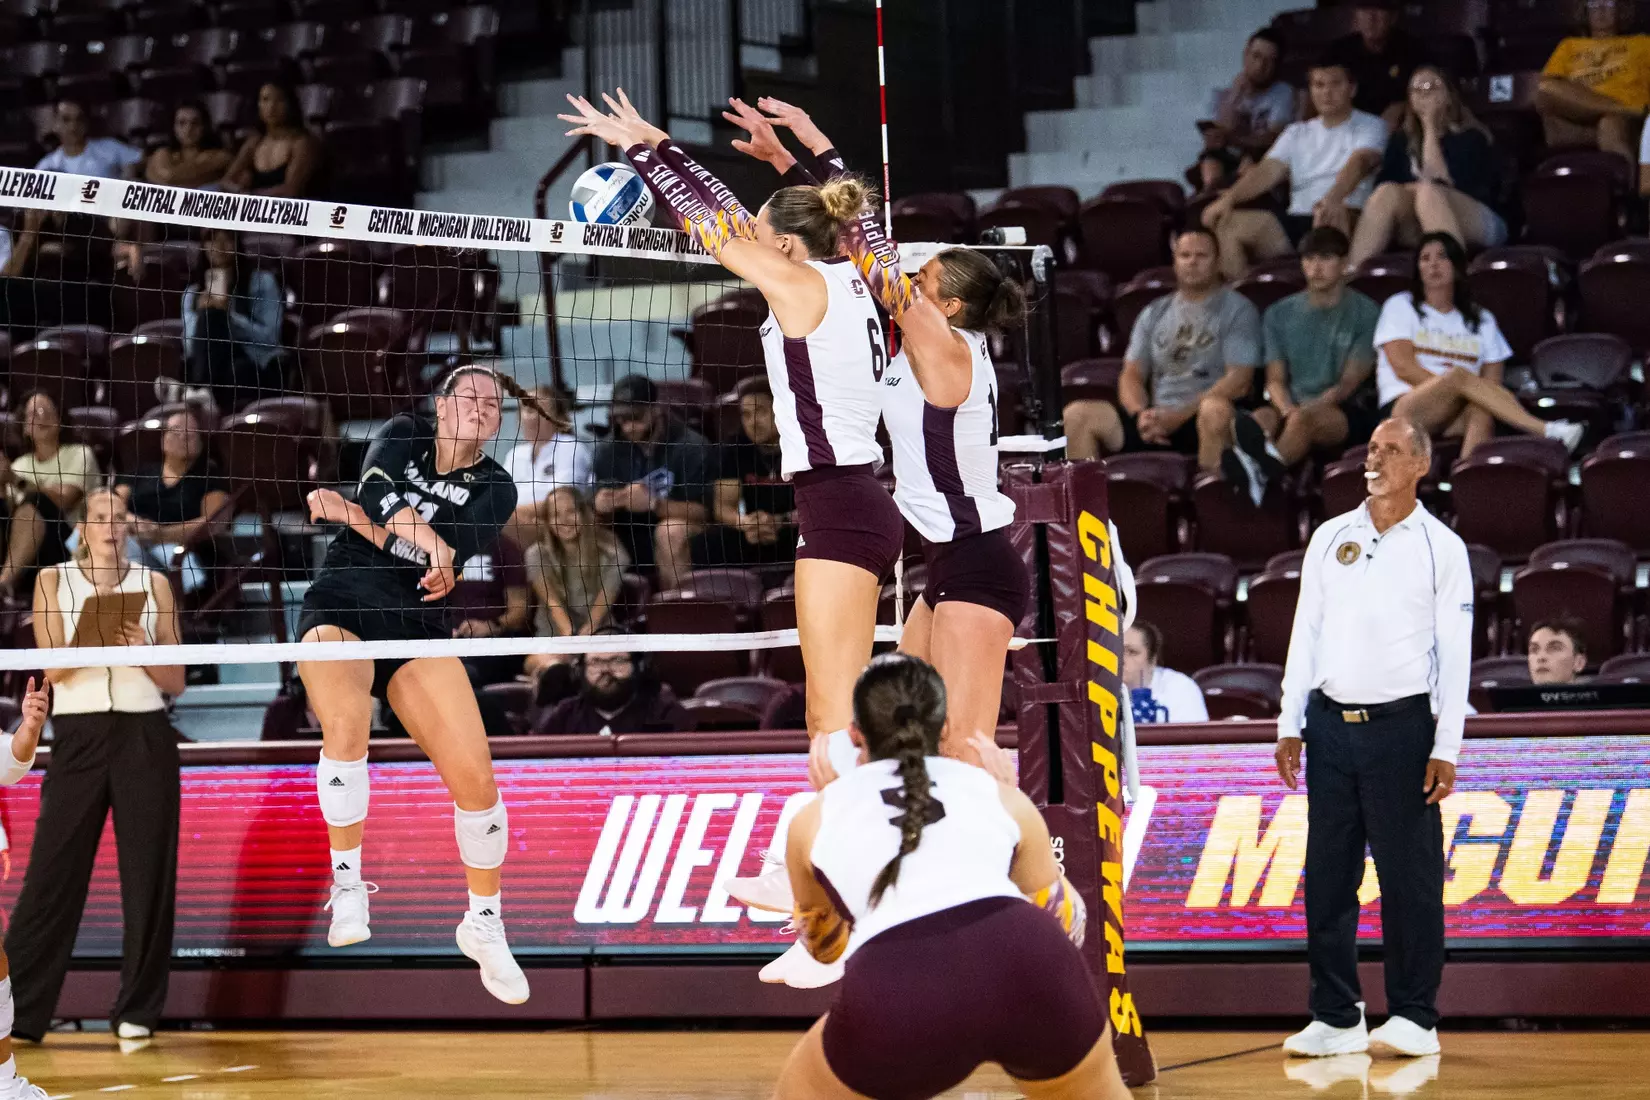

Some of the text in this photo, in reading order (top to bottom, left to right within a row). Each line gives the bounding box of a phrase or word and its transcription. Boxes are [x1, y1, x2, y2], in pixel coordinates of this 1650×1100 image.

[0, 170, 57, 200] LEYBALL
[121, 184, 178, 215] CENTRAL
[178, 191, 241, 221] MICHIGAN
[239, 198, 310, 226] VOLLEYBALL
[367, 208, 414, 235] CENTRAL
[416, 212, 470, 239] MICHIGAN
[470, 217, 531, 242] VOLLEYBALL
[582, 223, 624, 248] CENTRAL
[626, 226, 674, 252] MICHIGAN
[619, 193, 649, 226] molte
[647, 163, 715, 224] CHIPPEWAS
[857, 208, 901, 268] CHIPPE
[867, 318, 884, 382] 6
[1077, 510, 1143, 1038] CHIPPEWAS
